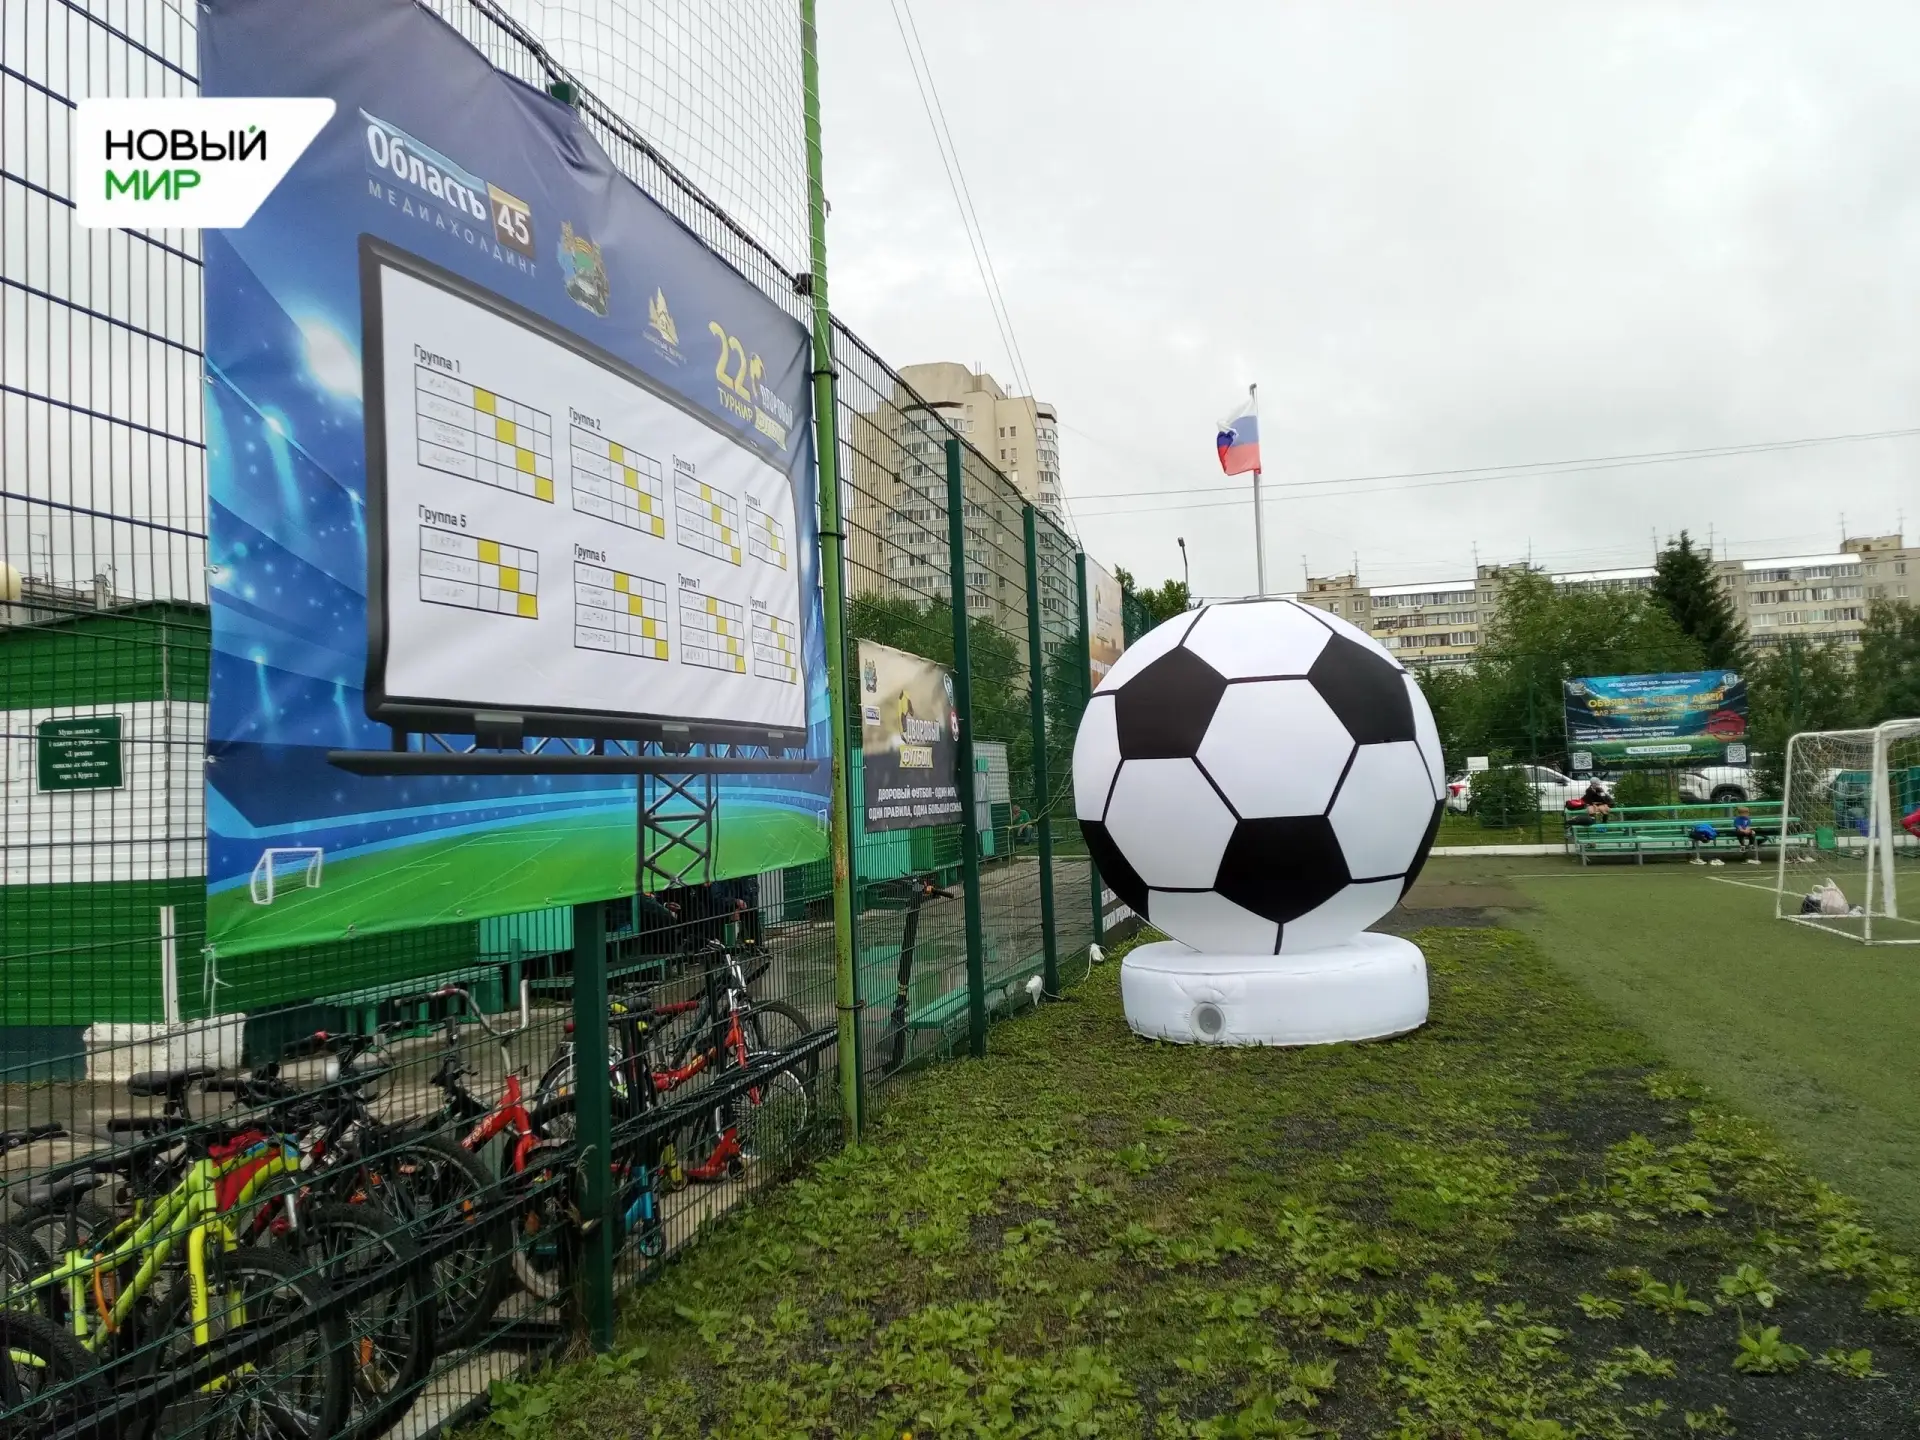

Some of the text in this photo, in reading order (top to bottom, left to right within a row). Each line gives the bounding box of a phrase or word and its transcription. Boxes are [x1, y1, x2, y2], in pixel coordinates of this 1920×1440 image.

[367, 124, 530, 245] Область 45
[368, 179, 537, 278] МЕДИАХОЛДИНГ
[414, 343, 453, 371] Группа
[568, 406, 595, 428] Группа
[717, 386, 753, 423] ТУРНИР
[418, 504, 467, 528] Группа 5
[574, 543, 606, 563] Группа 6
[878, 784, 911, 802] ДВОРОВЫЙ
